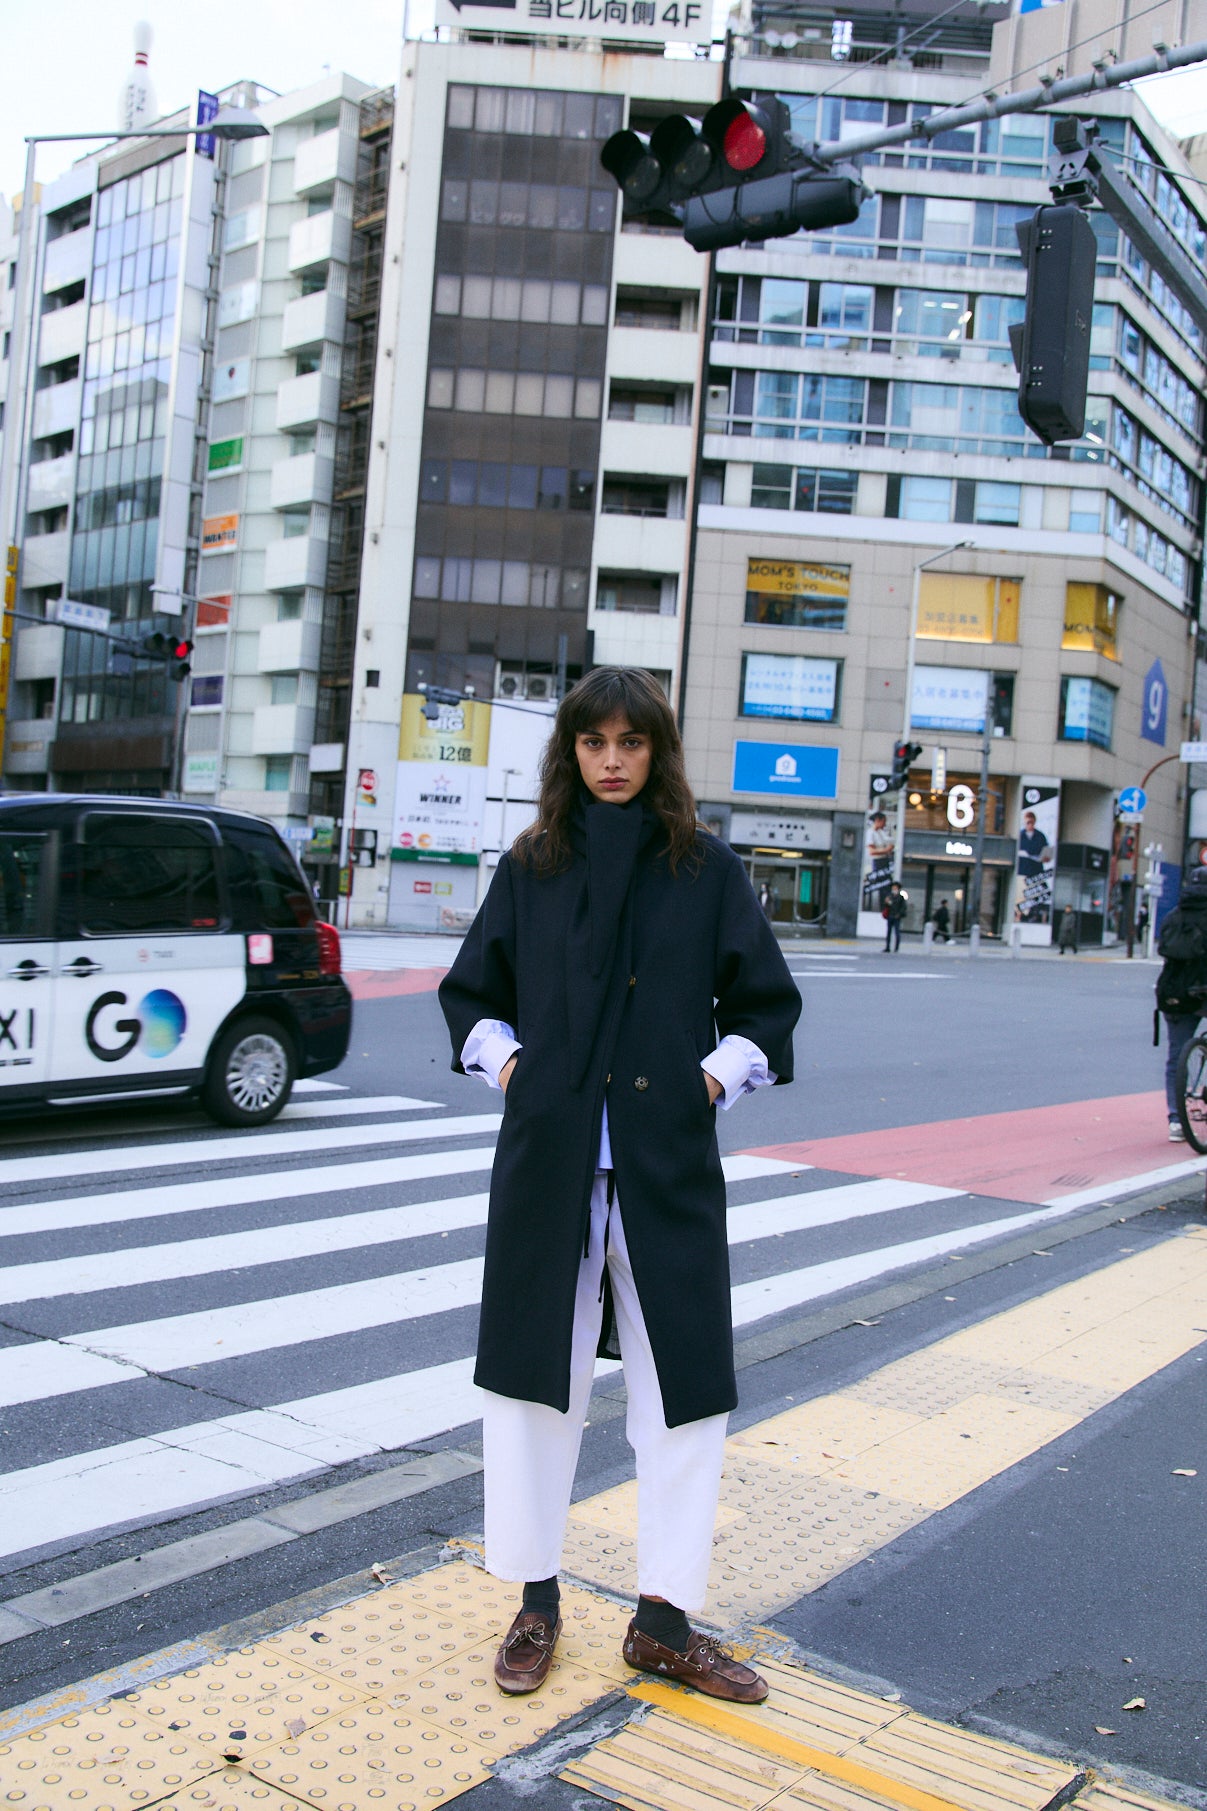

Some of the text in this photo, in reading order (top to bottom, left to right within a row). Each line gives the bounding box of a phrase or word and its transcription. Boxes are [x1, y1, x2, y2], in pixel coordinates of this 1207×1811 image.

[748, 564, 850, 581] MOM'S TOUCH
[779, 581, 818, 591] TOKYO
[440, 746, 472, 762] 12億
[420, 793, 462, 804] WINNER
